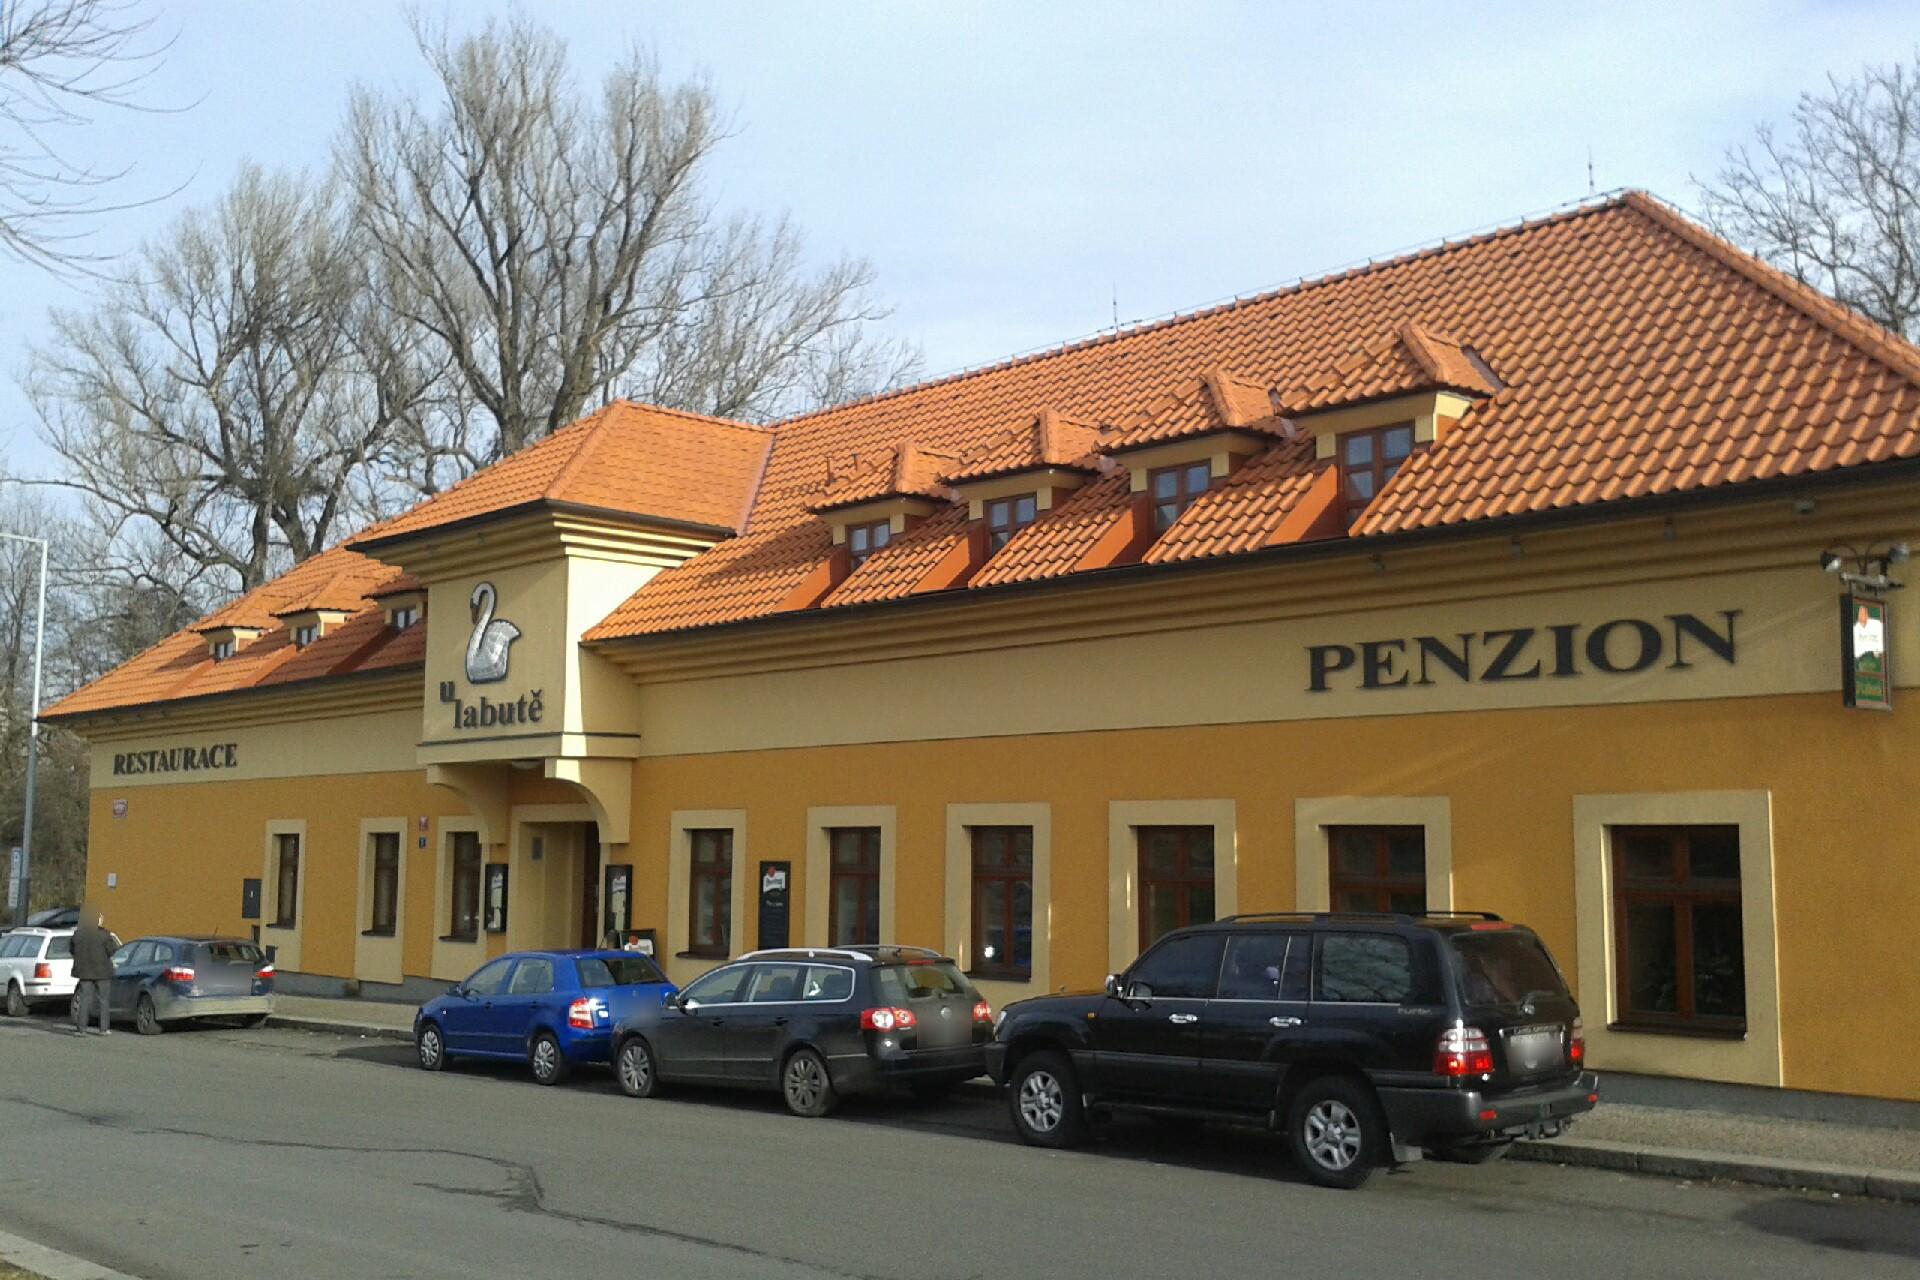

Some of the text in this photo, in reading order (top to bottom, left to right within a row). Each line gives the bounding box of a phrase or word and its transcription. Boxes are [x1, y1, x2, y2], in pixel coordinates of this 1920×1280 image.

[1304, 609, 1743, 692] PENZION
[440, 681, 543, 729] u labutě
[113, 744, 238, 775] RESTAURACE
